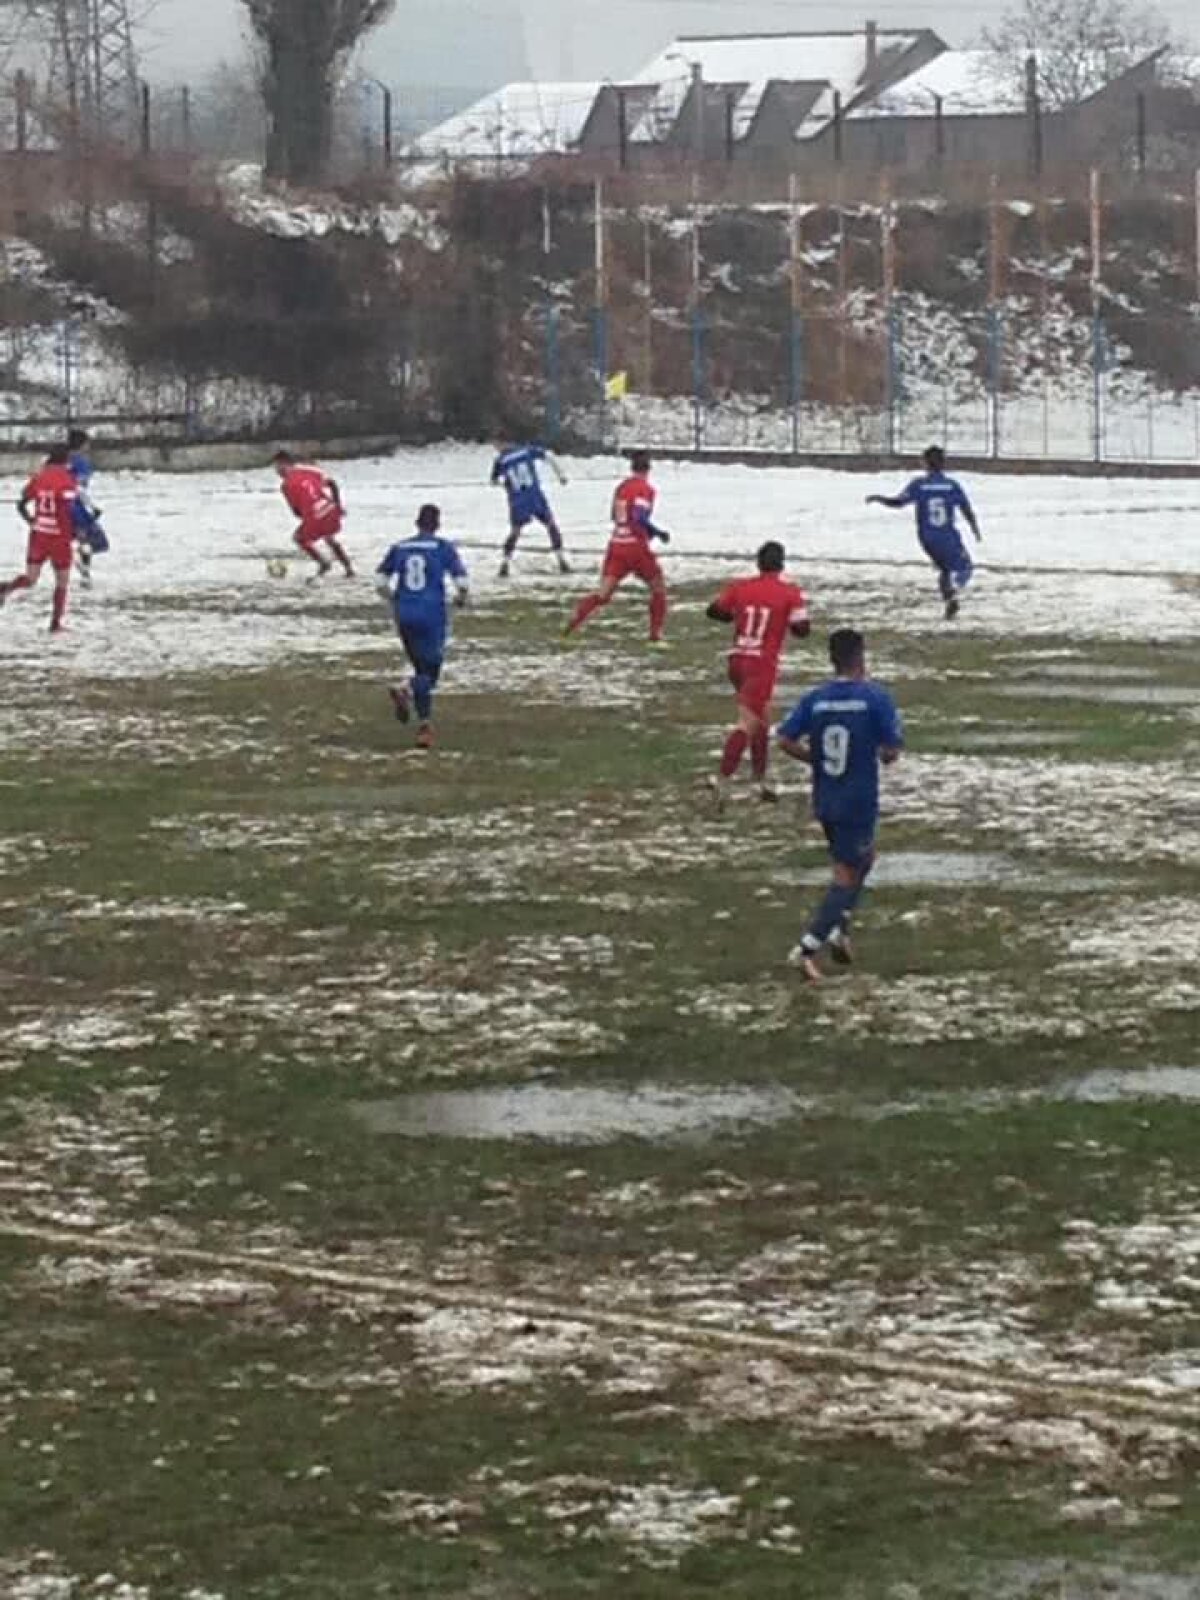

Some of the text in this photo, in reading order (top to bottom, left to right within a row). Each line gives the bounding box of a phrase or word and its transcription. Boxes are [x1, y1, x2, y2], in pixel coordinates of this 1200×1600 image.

[928, 497, 947, 527] 5
[405, 554, 426, 590] 8
[822, 724, 849, 776] 9
